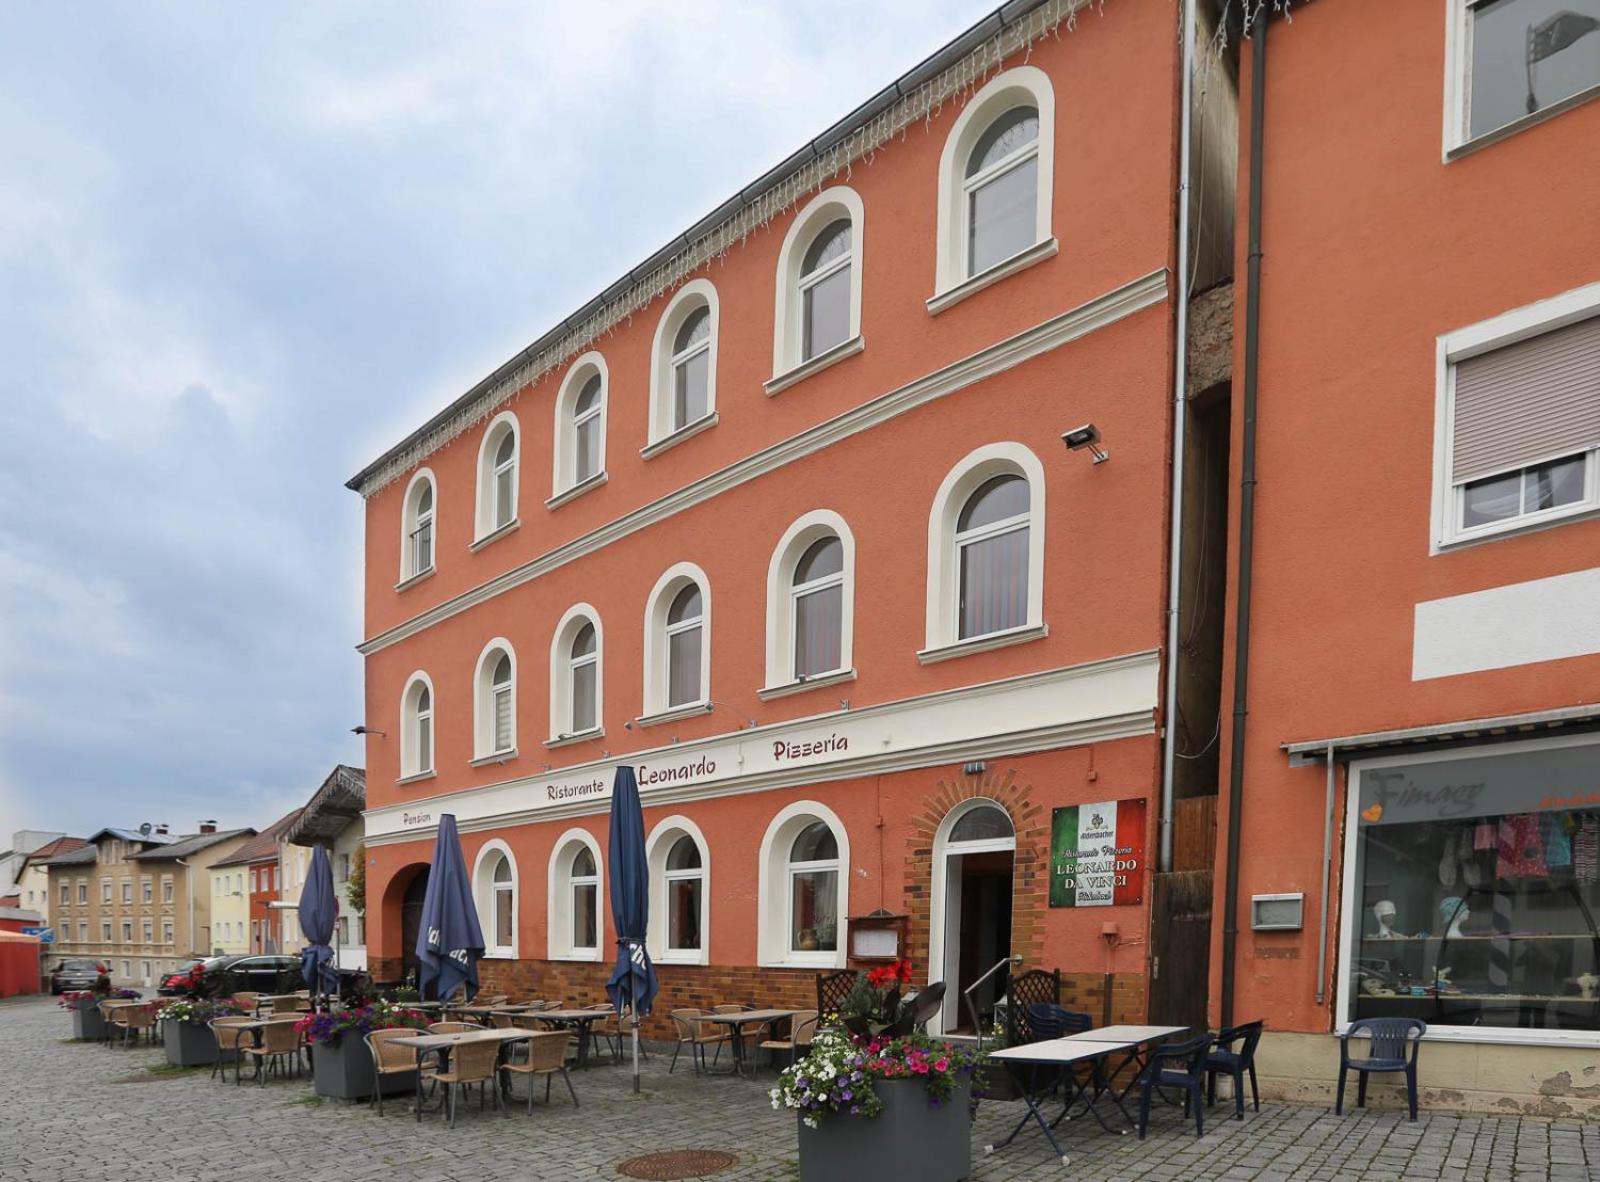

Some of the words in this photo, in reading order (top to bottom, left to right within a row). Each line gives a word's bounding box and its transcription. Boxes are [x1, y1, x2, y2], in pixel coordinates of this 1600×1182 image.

[774, 732, 849, 761] Pizzeria
[639, 756, 717, 786] Leonardo
[547, 779, 604, 799] Ristorante
[403, 812, 431, 825] Pension
[1057, 859, 1137, 874] LEONARDO
[1064, 877, 1083, 889] DA
[1087, 875, 1127, 888] VINCI
